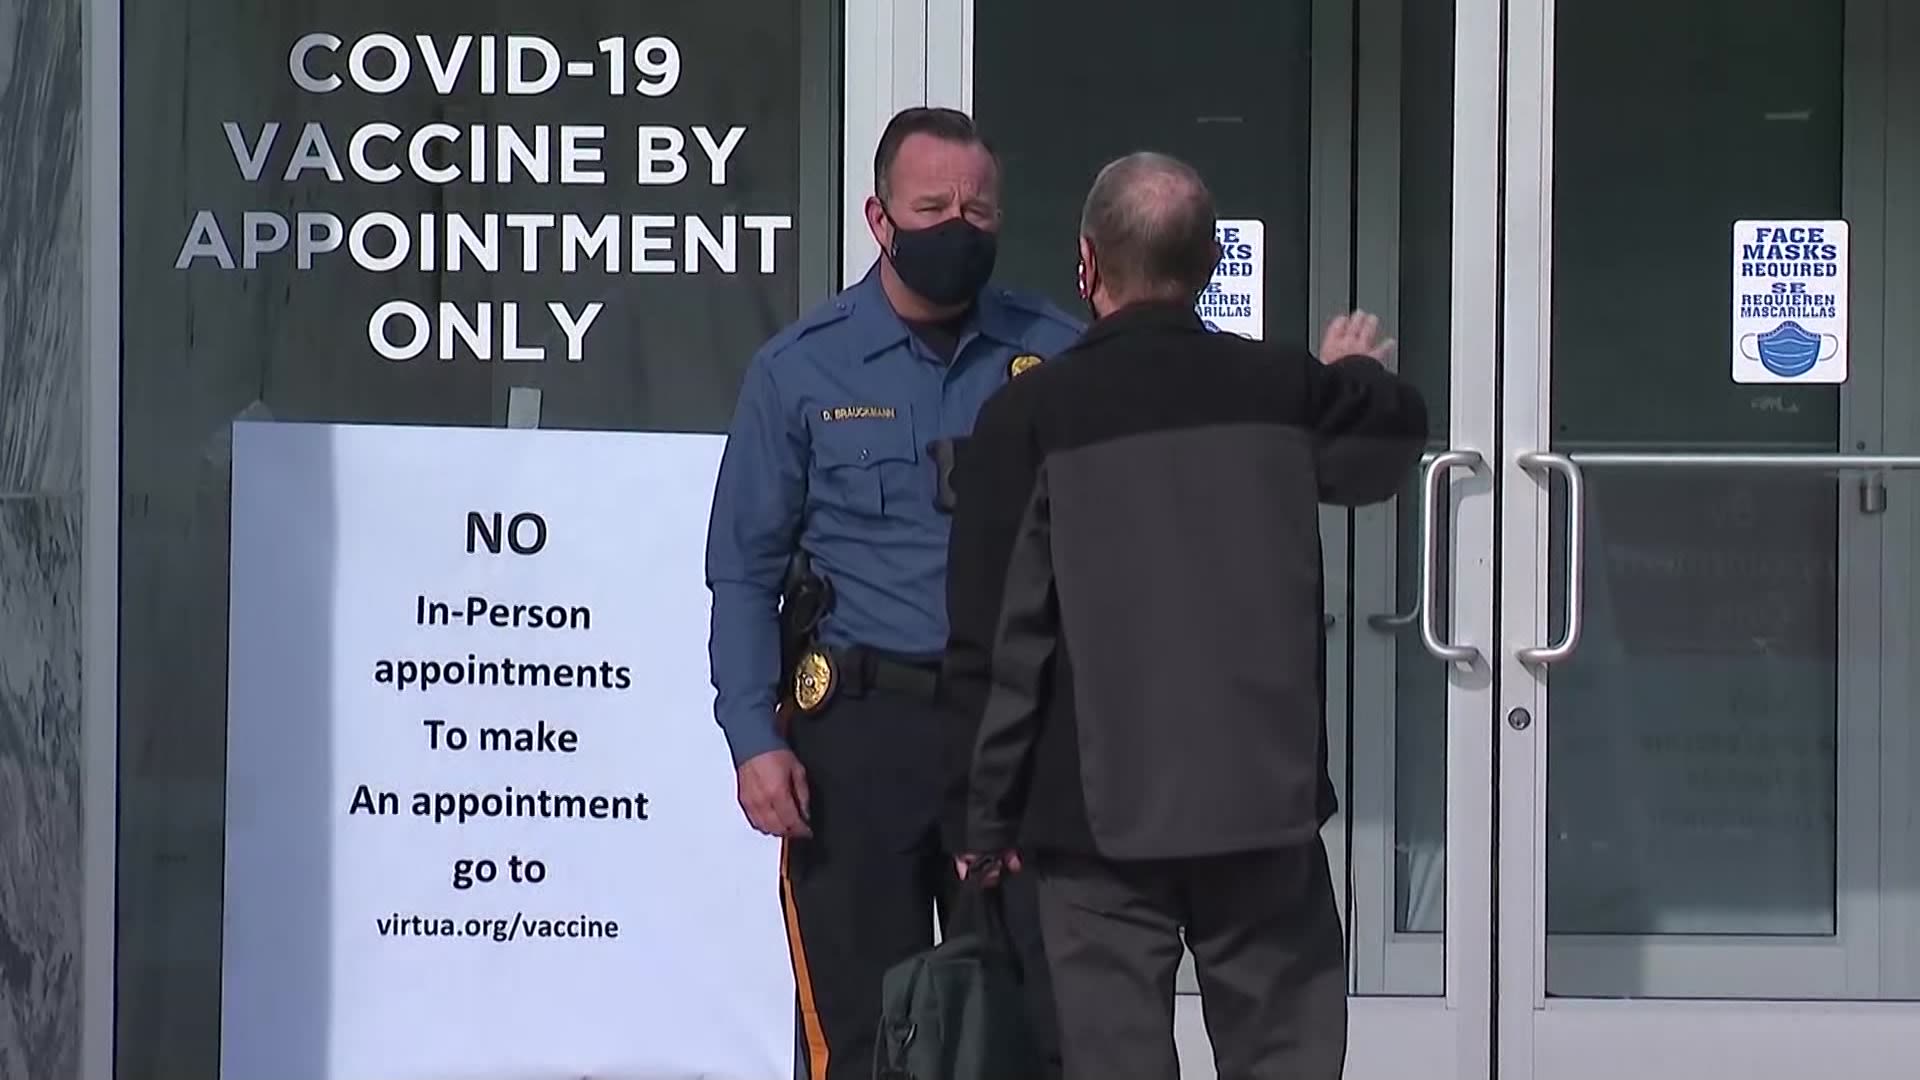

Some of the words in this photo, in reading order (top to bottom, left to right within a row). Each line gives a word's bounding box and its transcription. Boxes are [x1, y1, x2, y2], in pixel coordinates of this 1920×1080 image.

[289, 33, 681, 96] COVID-19
[223, 121, 606, 184] VACCINE
[638, 125, 746, 184] BY
[175, 210, 792, 273] APPOINTMENT
[1742, 244, 1837, 260] MASKS
[1755, 227, 1825, 243] FACE
[1741, 262, 1837, 277] REQUIRED
[1741, 294, 1835, 306] REQUIEREN
[1771, 282, 1807, 294] SE
[1740, 306, 1836, 318] MASCARILLAS
[368, 300, 603, 360] ONLY
[466, 511, 547, 555] NO
[417, 595, 590, 629] In-Person
[374, 654, 631, 691] appointments
[423, 719, 467, 751] To
[480, 720, 578, 753] make
[349, 784, 399, 815] An
[411, 786, 649, 823] appointment
[452, 859, 497, 889] go
[508, 855, 546, 884] to
[376, 911, 619, 942] virtua.org/vaccine
